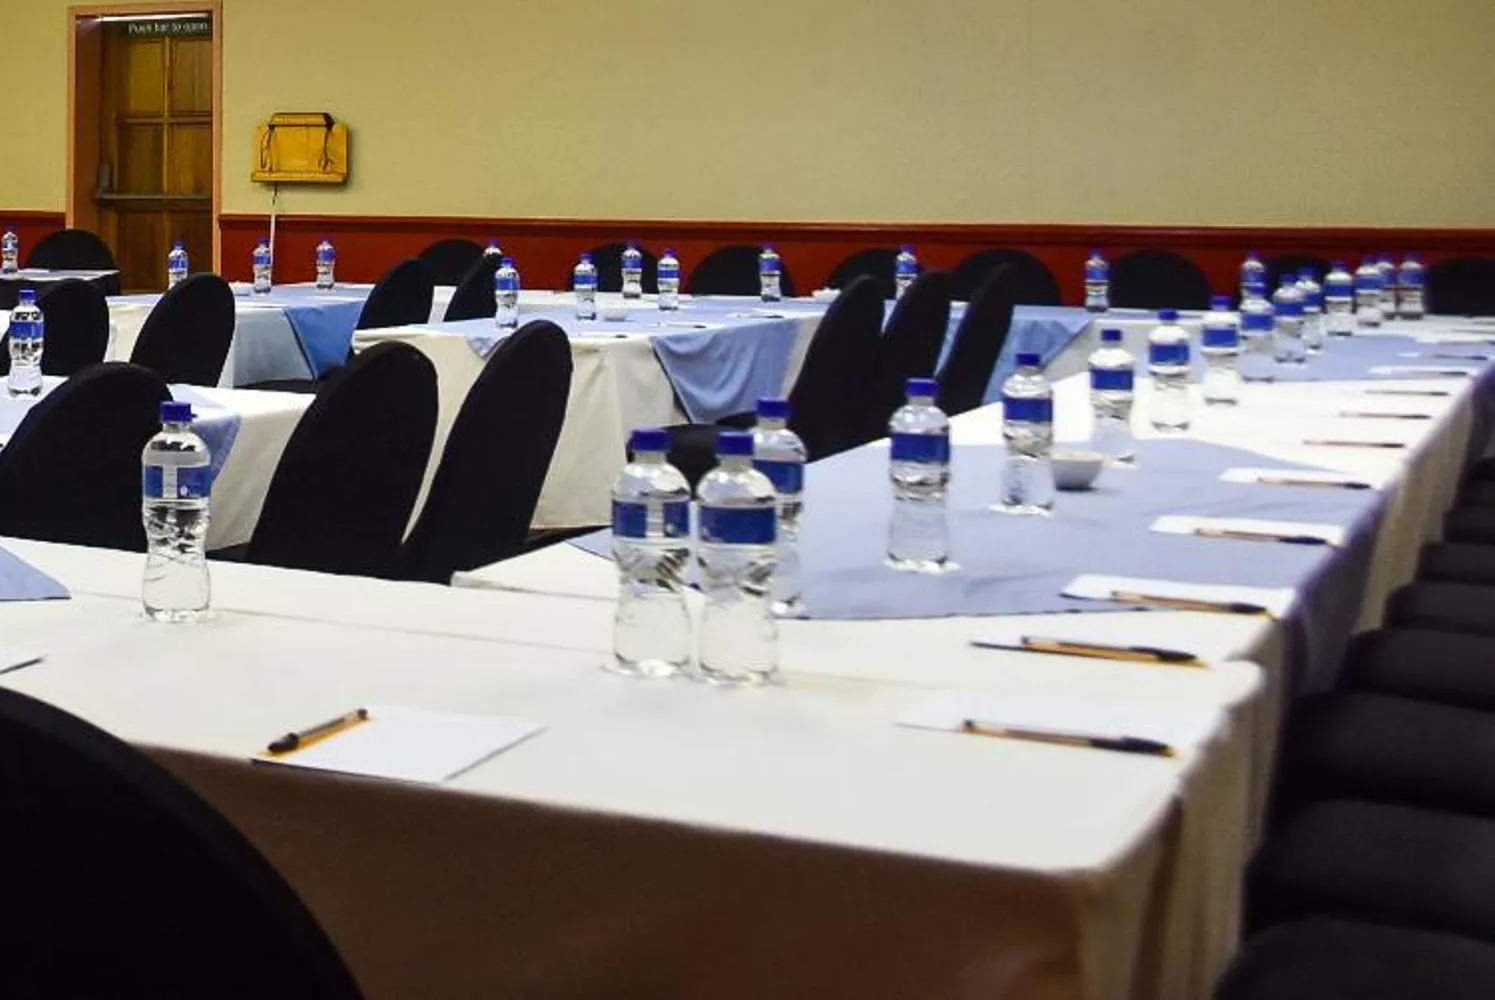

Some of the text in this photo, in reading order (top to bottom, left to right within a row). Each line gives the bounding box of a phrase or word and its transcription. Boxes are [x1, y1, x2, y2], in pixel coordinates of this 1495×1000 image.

[128, 22, 152, 35] Push
[154, 22, 169, 33] bar
[172, 21, 182, 33] to
